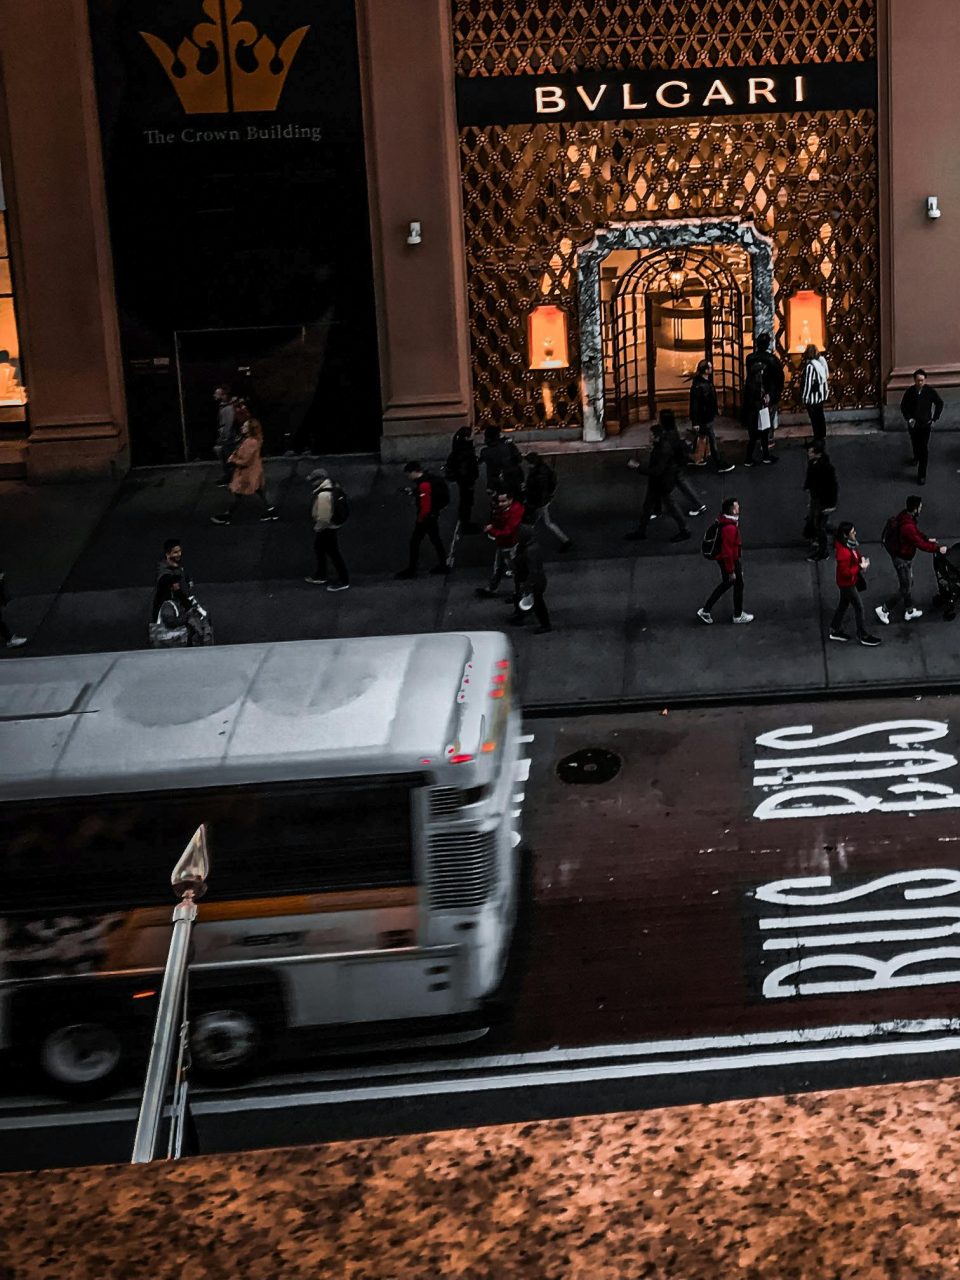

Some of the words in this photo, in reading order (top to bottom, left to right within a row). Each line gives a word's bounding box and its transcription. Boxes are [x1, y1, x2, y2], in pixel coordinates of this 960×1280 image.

[534, 75, 804, 114] BVLGARI
[143, 129, 176, 144] The
[181, 128, 240, 143] Crown
[247, 124, 322, 142] Building
